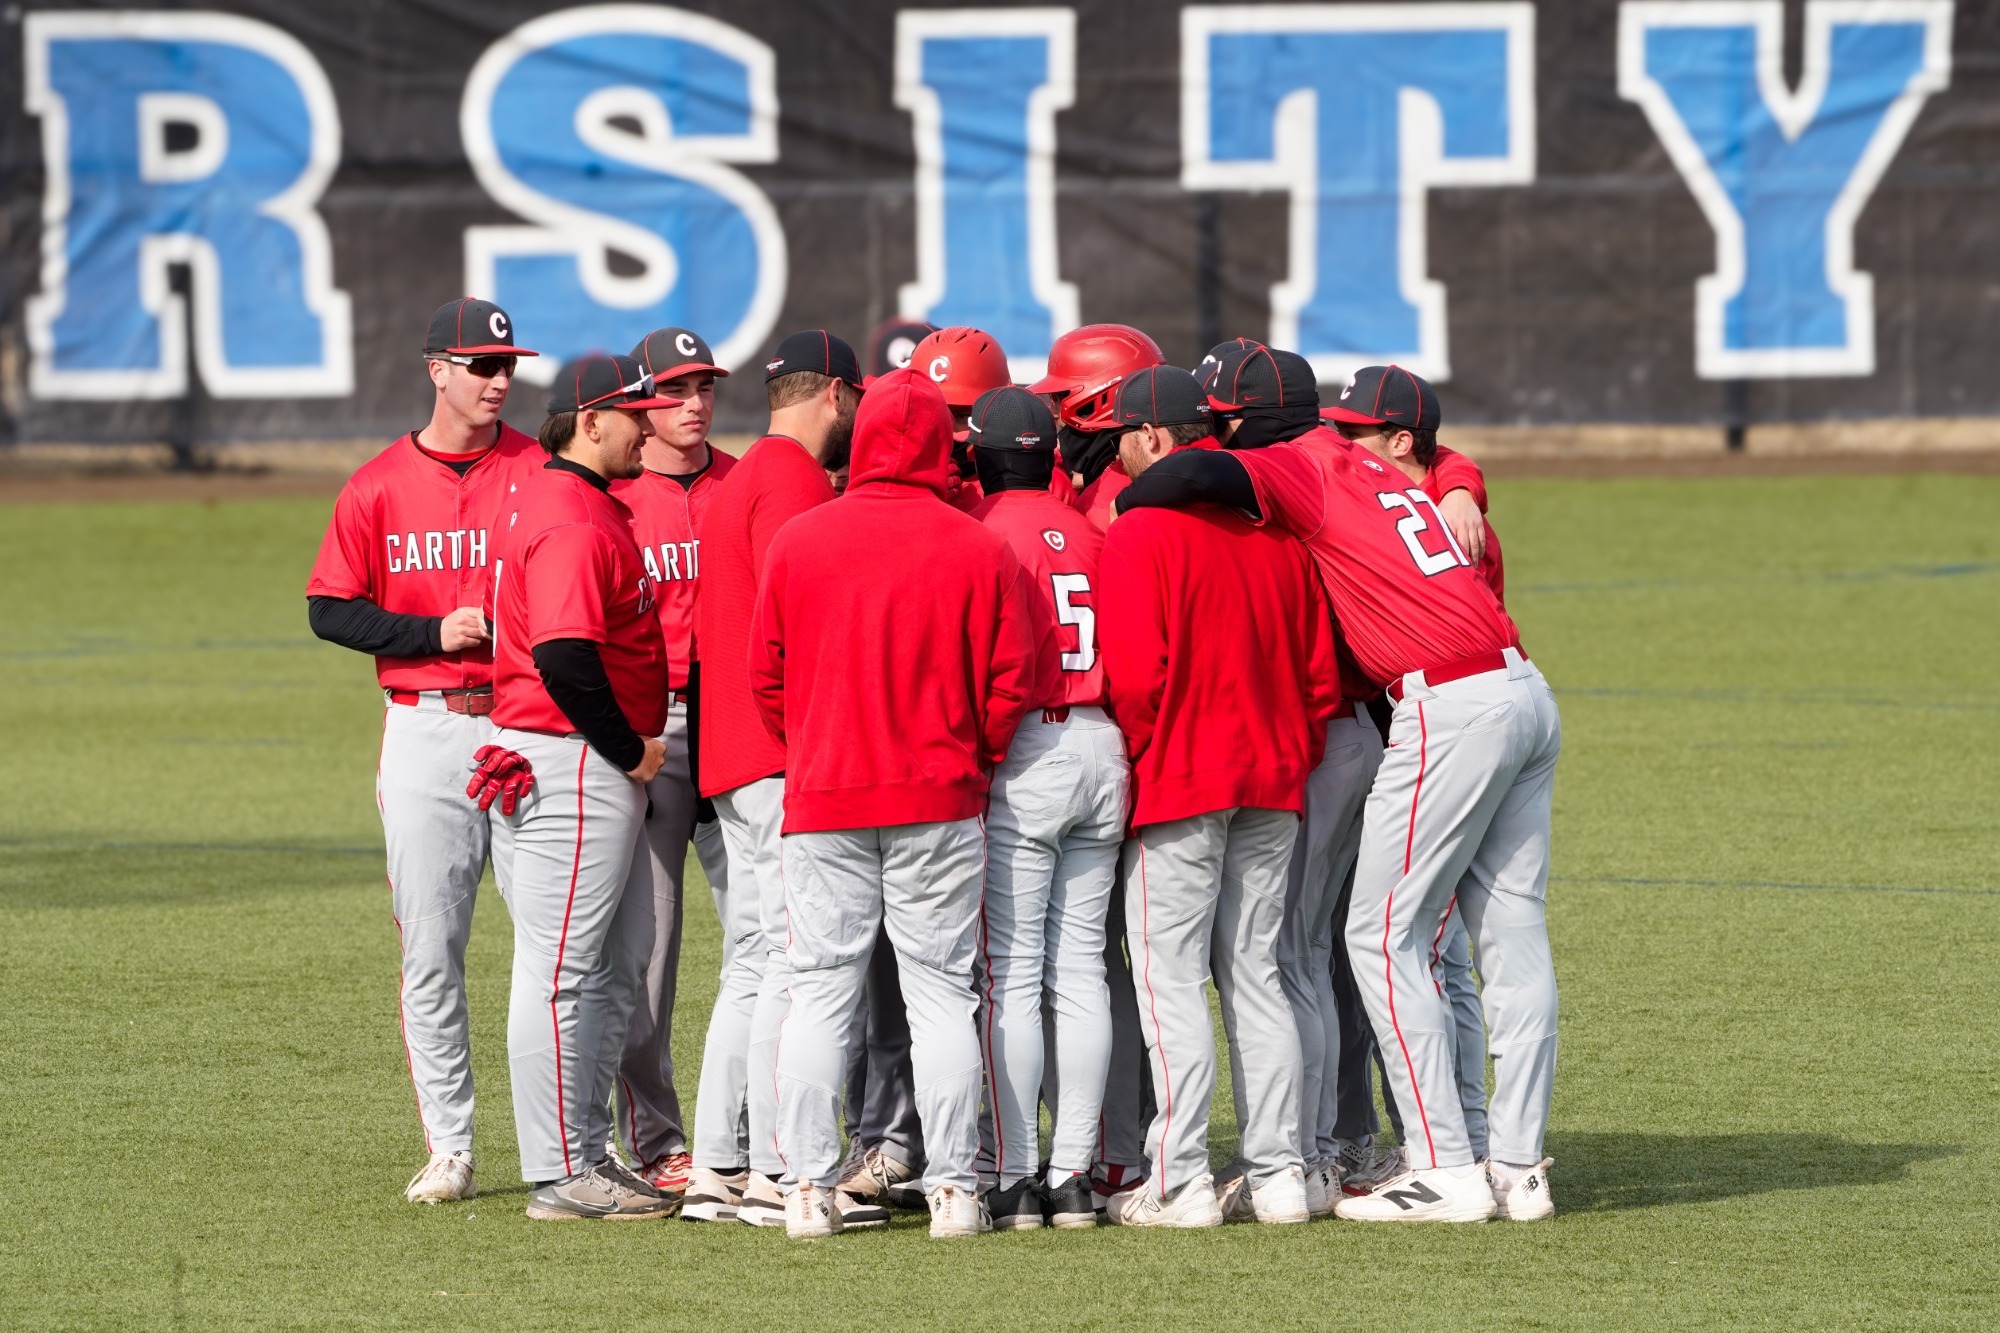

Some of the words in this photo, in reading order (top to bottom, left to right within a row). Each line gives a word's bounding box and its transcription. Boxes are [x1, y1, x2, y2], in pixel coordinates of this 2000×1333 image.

[489, 312, 508, 339] C
[675, 333, 697, 357] C
[929, 355, 949, 382] C
[386, 527, 488, 574] CARTH
[1051, 572, 1096, 673] 5
[1382, 1180, 1443, 1211] N
